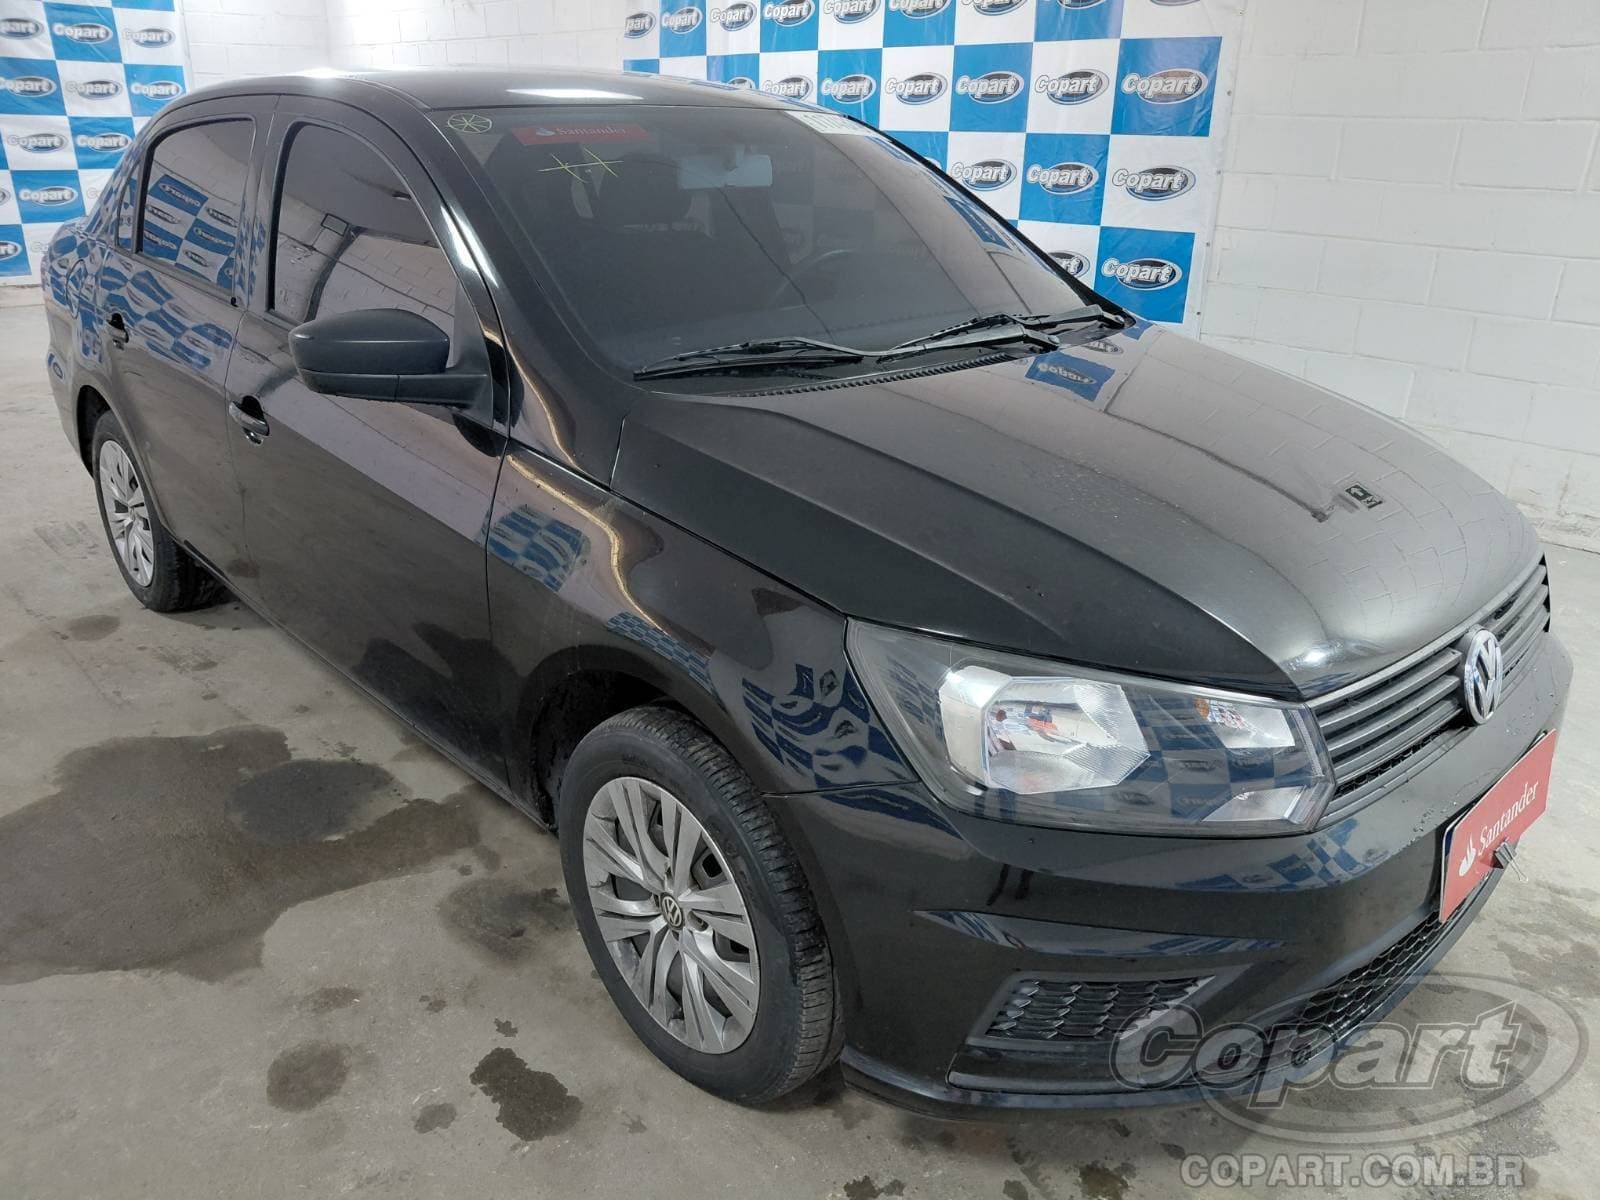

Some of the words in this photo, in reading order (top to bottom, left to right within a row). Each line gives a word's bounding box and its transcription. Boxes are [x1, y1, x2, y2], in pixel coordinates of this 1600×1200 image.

[662, 10, 698, 28] Copart
[710, 5, 752, 26] Copart
[764, 1, 809, 22] Copart
[824, 0, 872, 18] Copart
[53, 22, 107, 41] Copart
[122, 28, 170, 43] Copart
[65, 80, 116, 96] Copart
[131, 83, 178, 97] Copart
[762, 79, 808, 97] Copart
[821, 78, 869, 99] Copart
[885, 73, 940, 100] Copart
[955, 74, 1016, 101] Copart
[1034, 73, 1101, 101] Copart
[1122, 72, 1199, 101] Copart
[556, 125, 627, 136] Santander
[8, 135, 62, 151] Copart
[77, 134, 126, 150] Copart
[951, 161, 1008, 188] Copart
[1027, 164, 1091, 190] Copart
[1112, 168, 1187, 196] Copart
[20, 188, 72, 204] Copart
[1101, 258, 1173, 283] Copart
[1478, 780, 1539, 856] Santander
